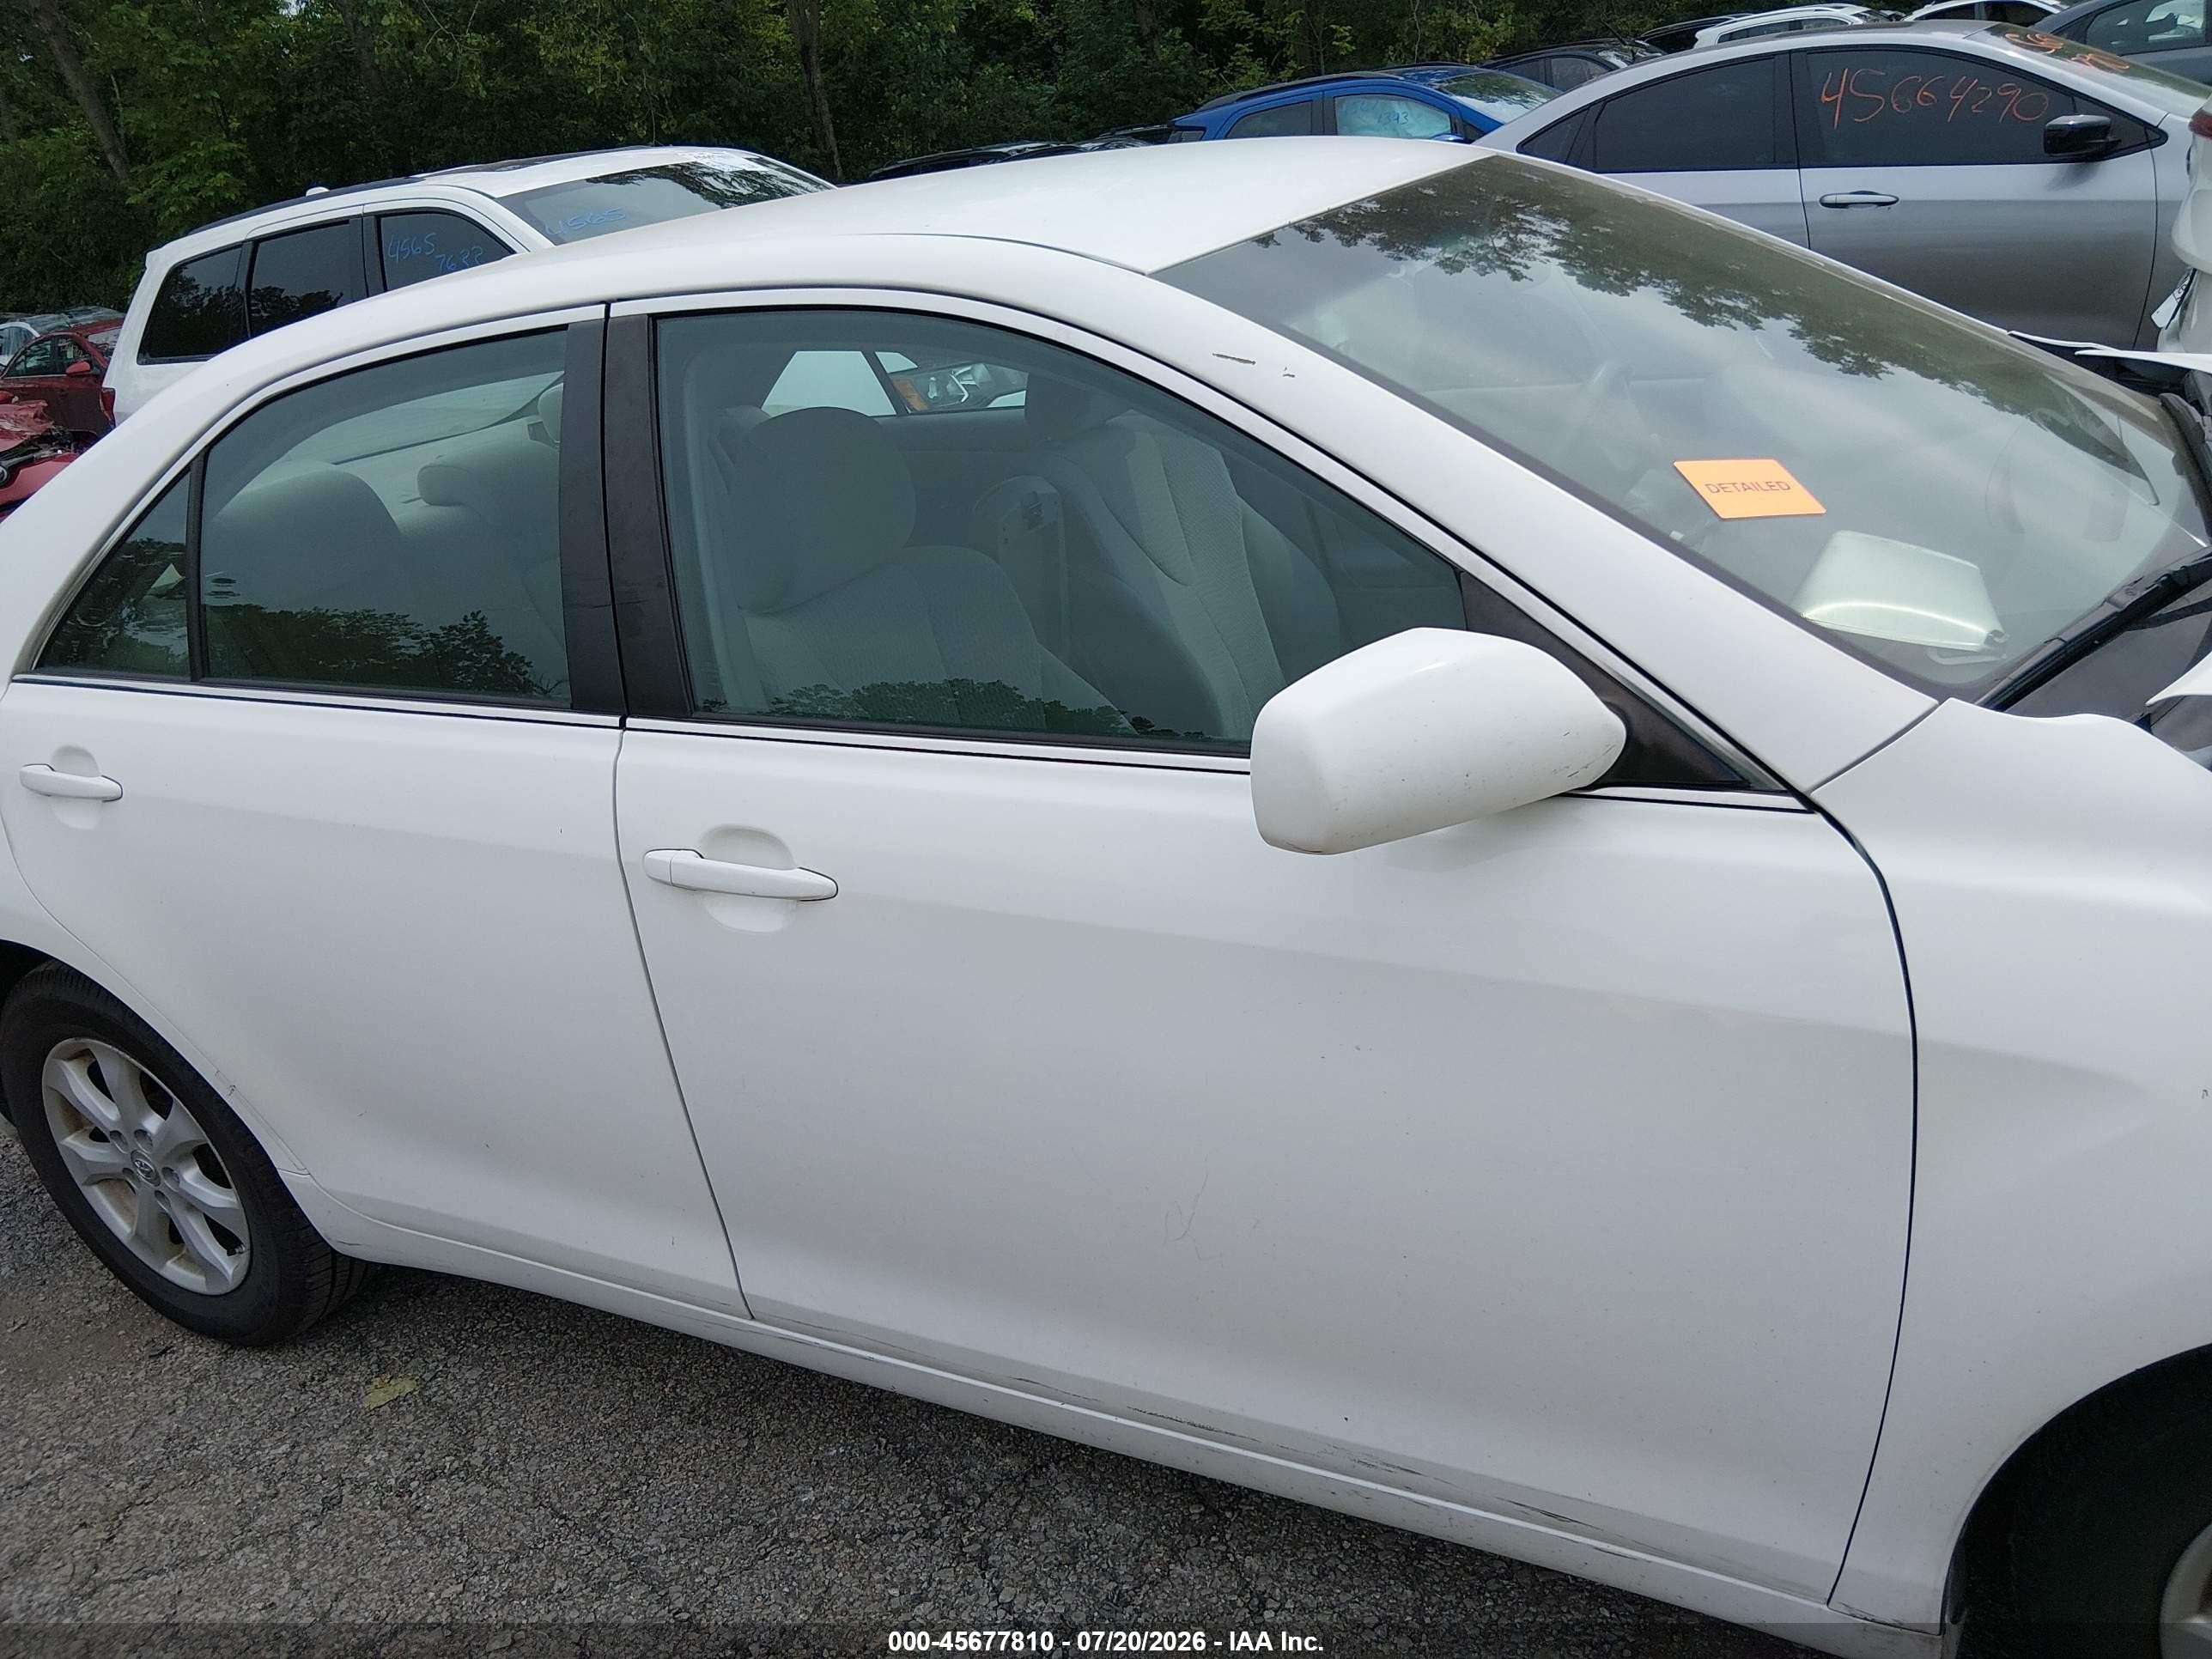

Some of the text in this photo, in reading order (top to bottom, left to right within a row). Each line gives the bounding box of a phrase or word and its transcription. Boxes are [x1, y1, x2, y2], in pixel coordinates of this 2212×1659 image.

[1821, 68, 2049, 129] 45664290
[387, 233, 436, 263] 4565
[1705, 481, 1791, 494] DETAILED
